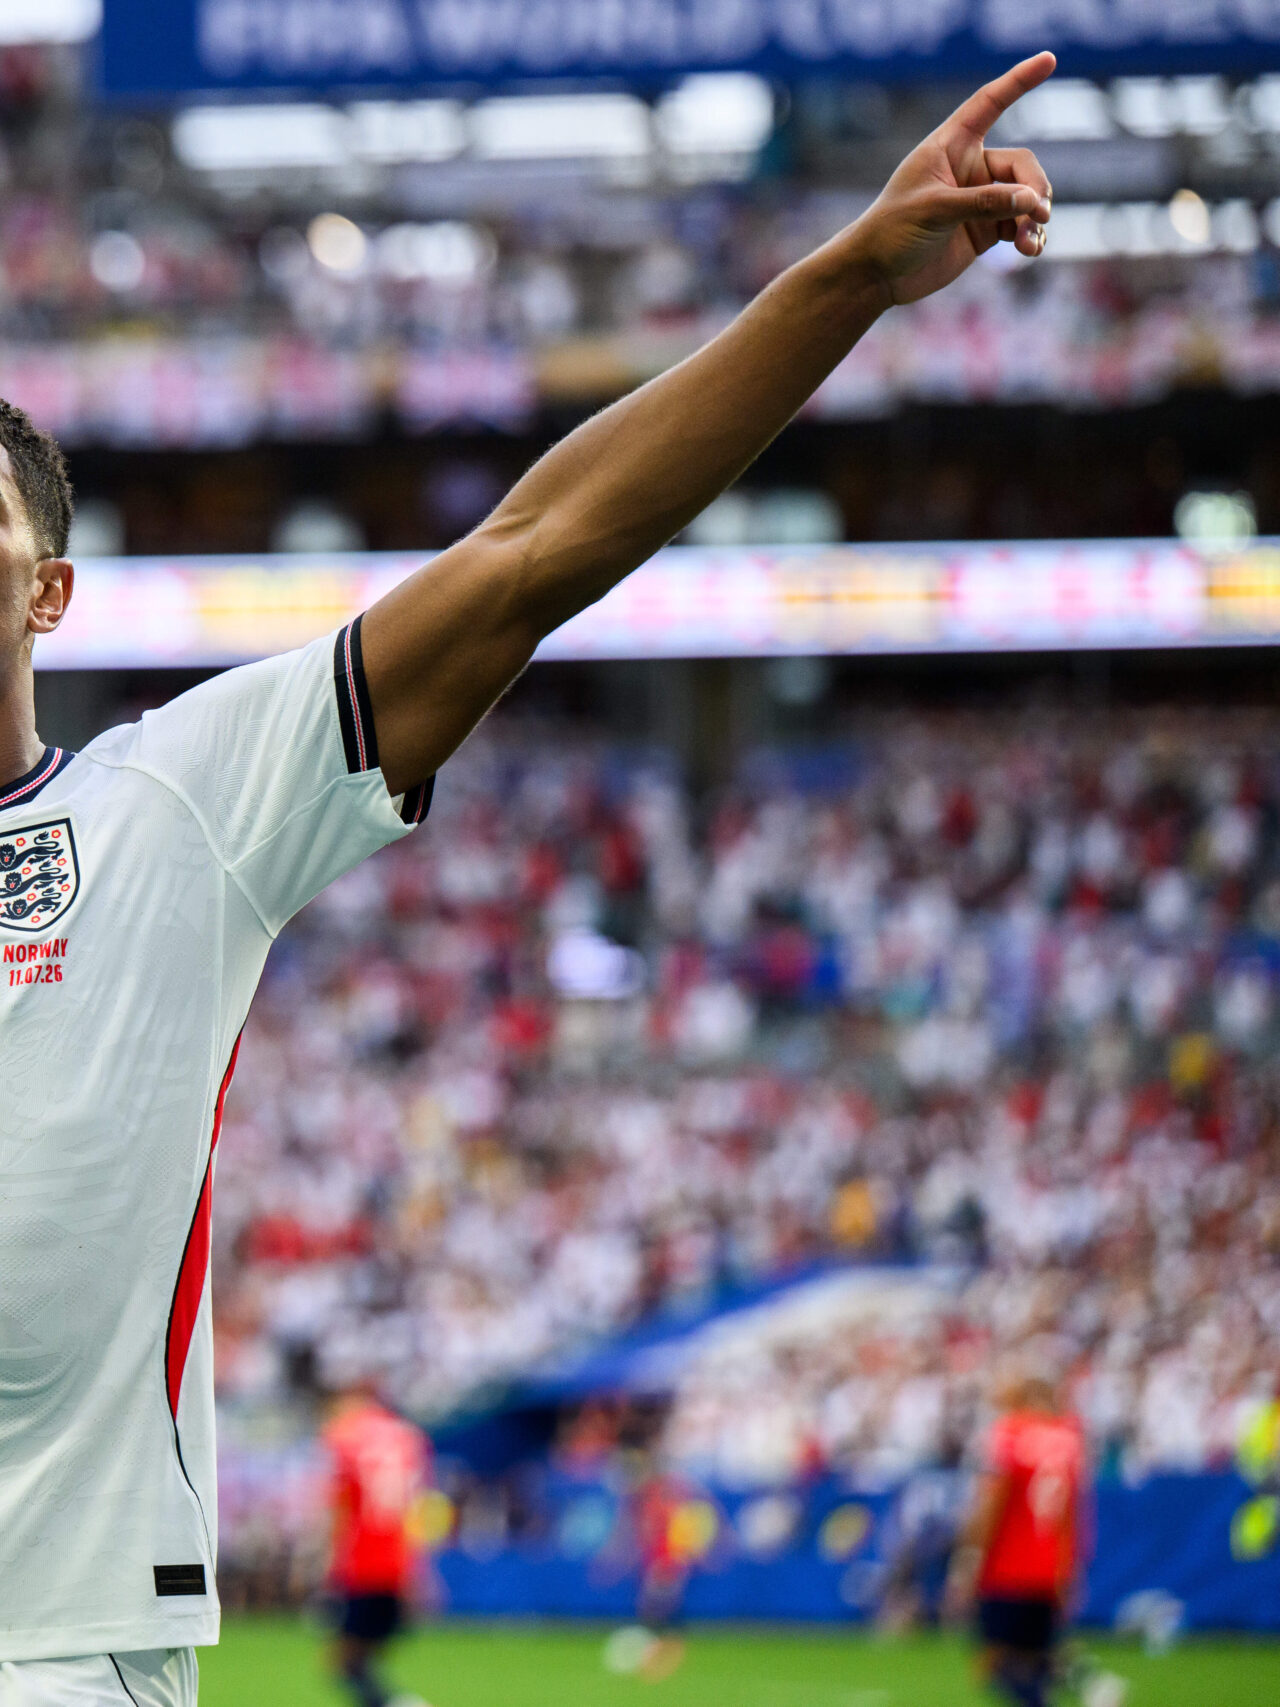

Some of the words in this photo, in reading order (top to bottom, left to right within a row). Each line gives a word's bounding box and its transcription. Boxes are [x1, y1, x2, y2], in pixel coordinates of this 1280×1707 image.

[198, 0, 402, 72] FIFA
[418, 0, 764, 66] WORLD
[3, 938, 68, 963] NORWAY
[9, 964, 62, 986] 11.07.26
